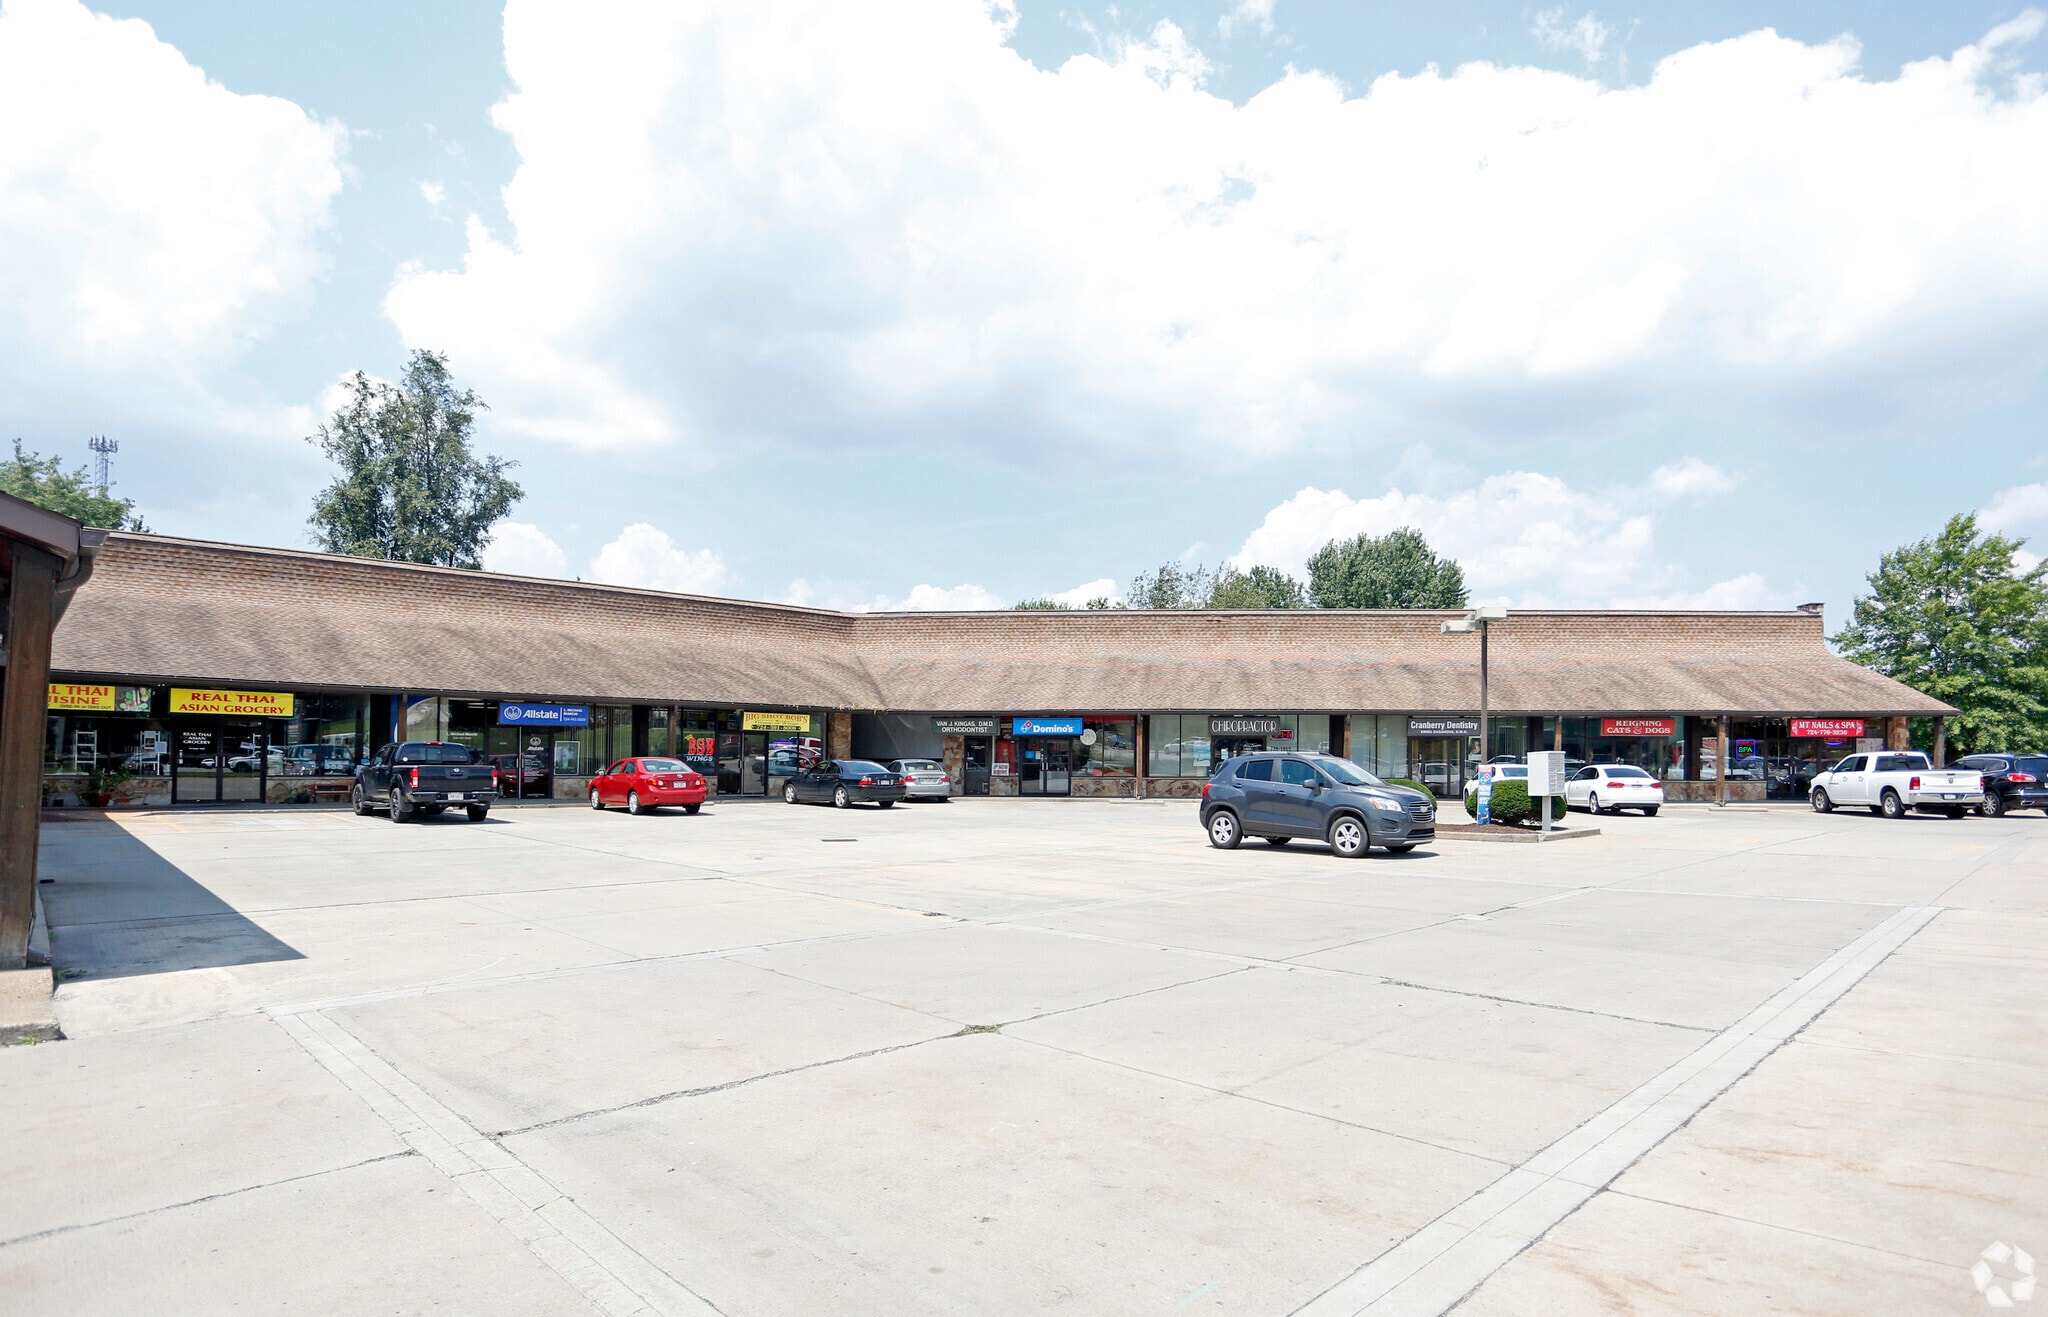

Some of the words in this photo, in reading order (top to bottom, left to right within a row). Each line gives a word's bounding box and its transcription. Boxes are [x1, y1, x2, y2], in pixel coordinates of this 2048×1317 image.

[65, 685, 108, 696] THAI
[191, 692, 231, 702] REAL
[236, 694, 275, 703] THAI
[179, 704, 220, 712] ASIAN
[223, 705, 285, 714] GROCERY
[522, 709, 559, 719] Allstate
[745, 713, 760, 722] BIG
[785, 715, 808, 723] BOB'S
[1033, 724, 1074, 733] Domino's
[1211, 720, 1277, 733] CHIROPRACTOR
[1410, 721, 1445, 730] Cranberry
[1447, 721, 1478, 731] Dentistry
[1798, 721, 1811, 729] MT
[1811, 721, 1833, 729] NAILS
[1841, 721, 1855, 729] SPA
[1633, 727, 1642, 735] &
[688, 737, 715, 756] BSB
